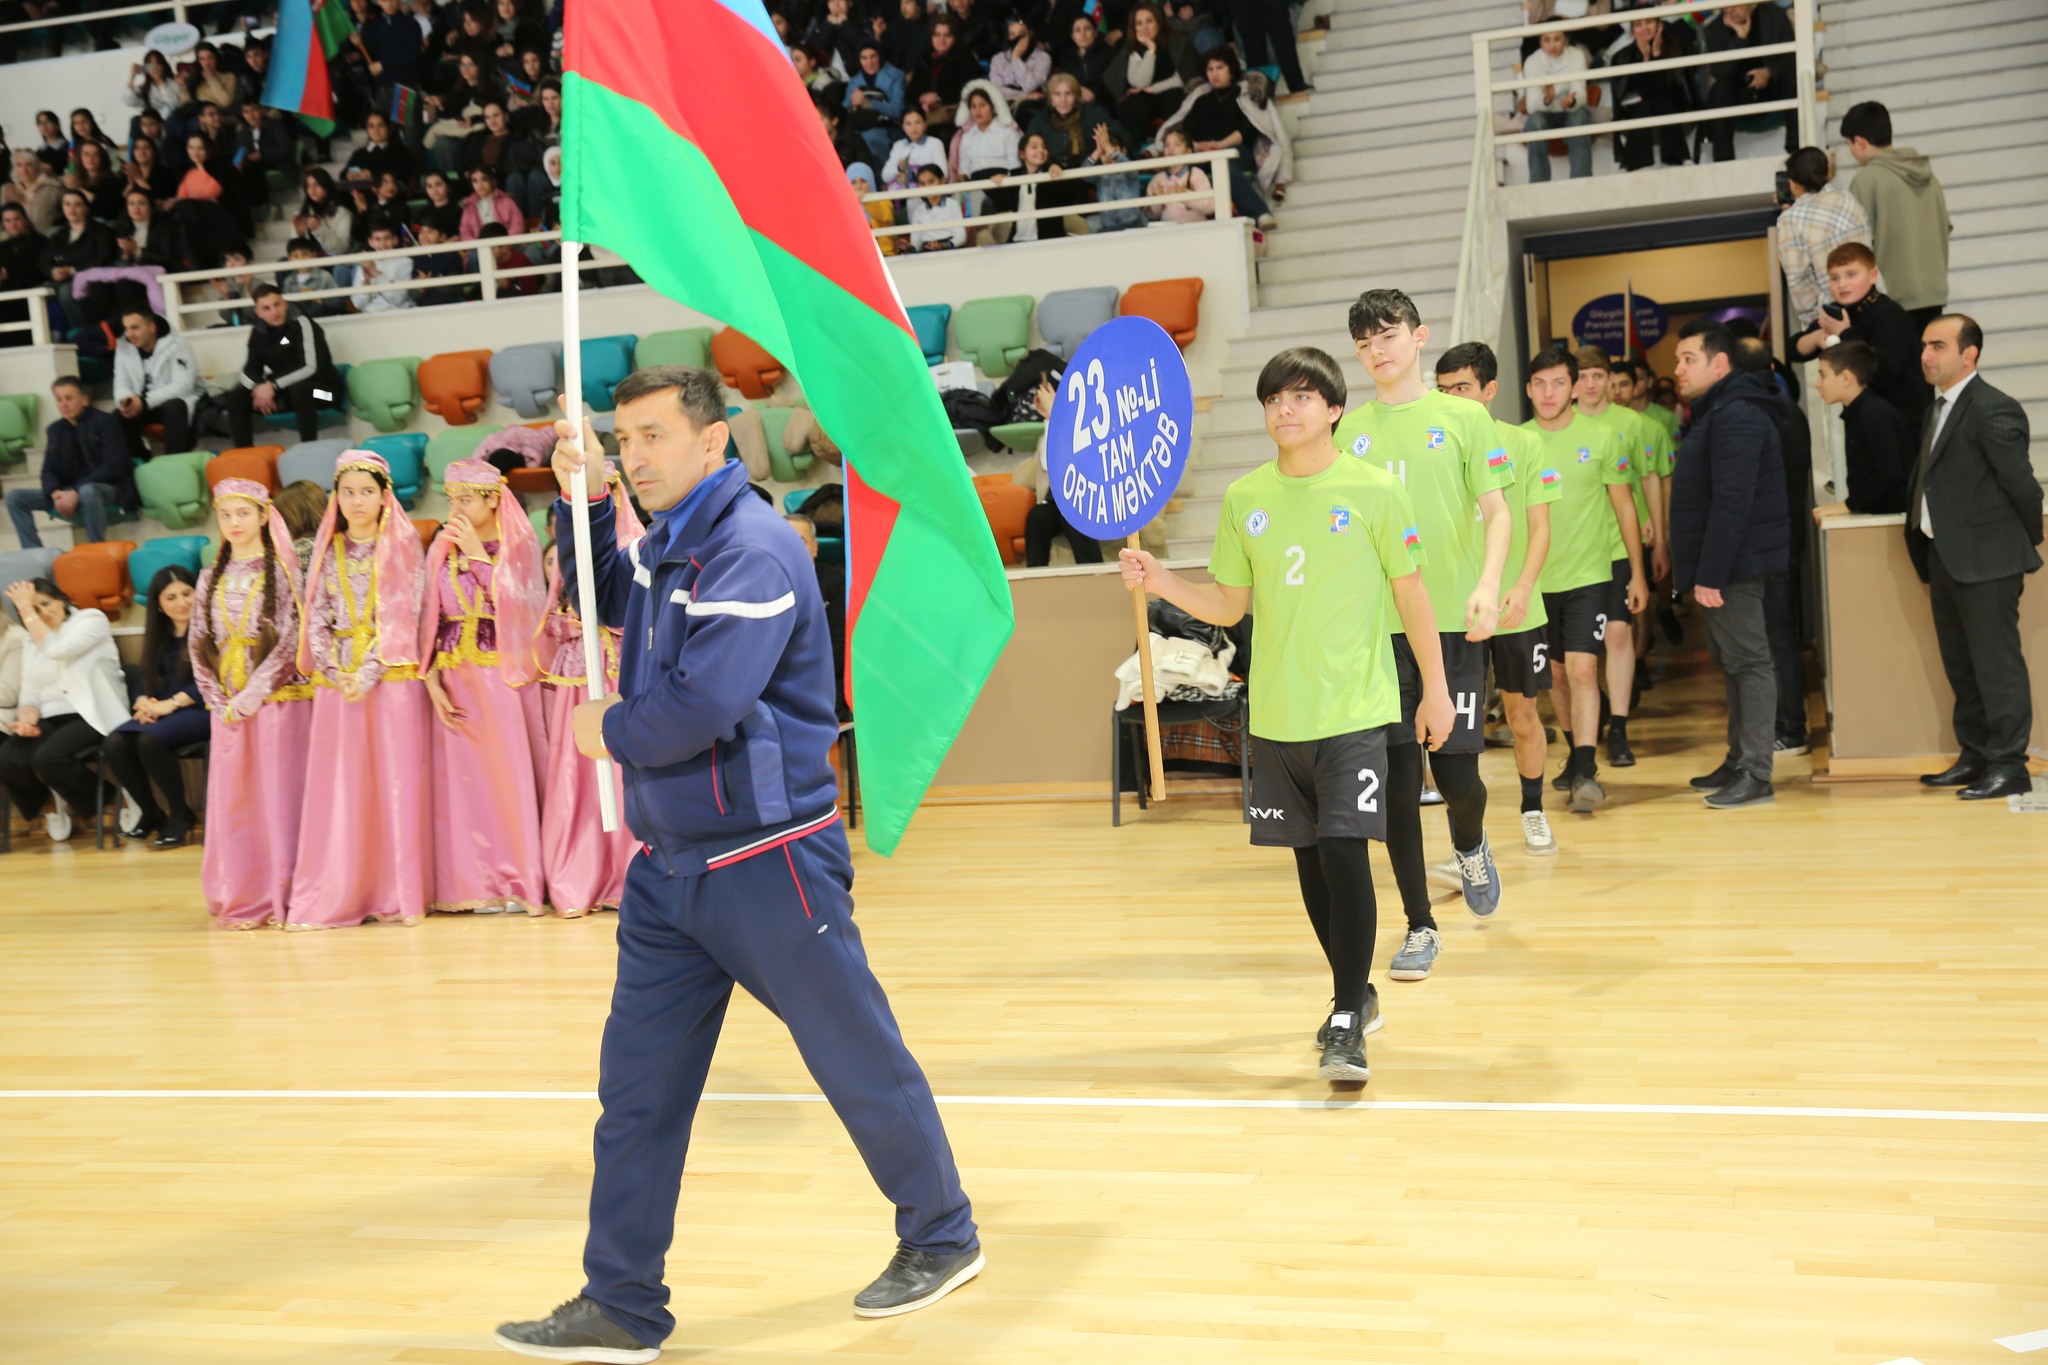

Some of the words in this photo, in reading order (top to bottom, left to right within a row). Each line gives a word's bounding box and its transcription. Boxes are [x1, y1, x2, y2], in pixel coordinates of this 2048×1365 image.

[1068, 358, 1111, 454] 23
[1098, 430, 1136, 482] TAM
[1063, 463, 1109, 524] ORTA
[1285, 546, 1305, 586] 2
[1593, 613, 1607, 641] 3
[1533, 643, 1549, 674] 5
[1456, 692, 1476, 730] 4
[1356, 768, 1380, 813] 2
